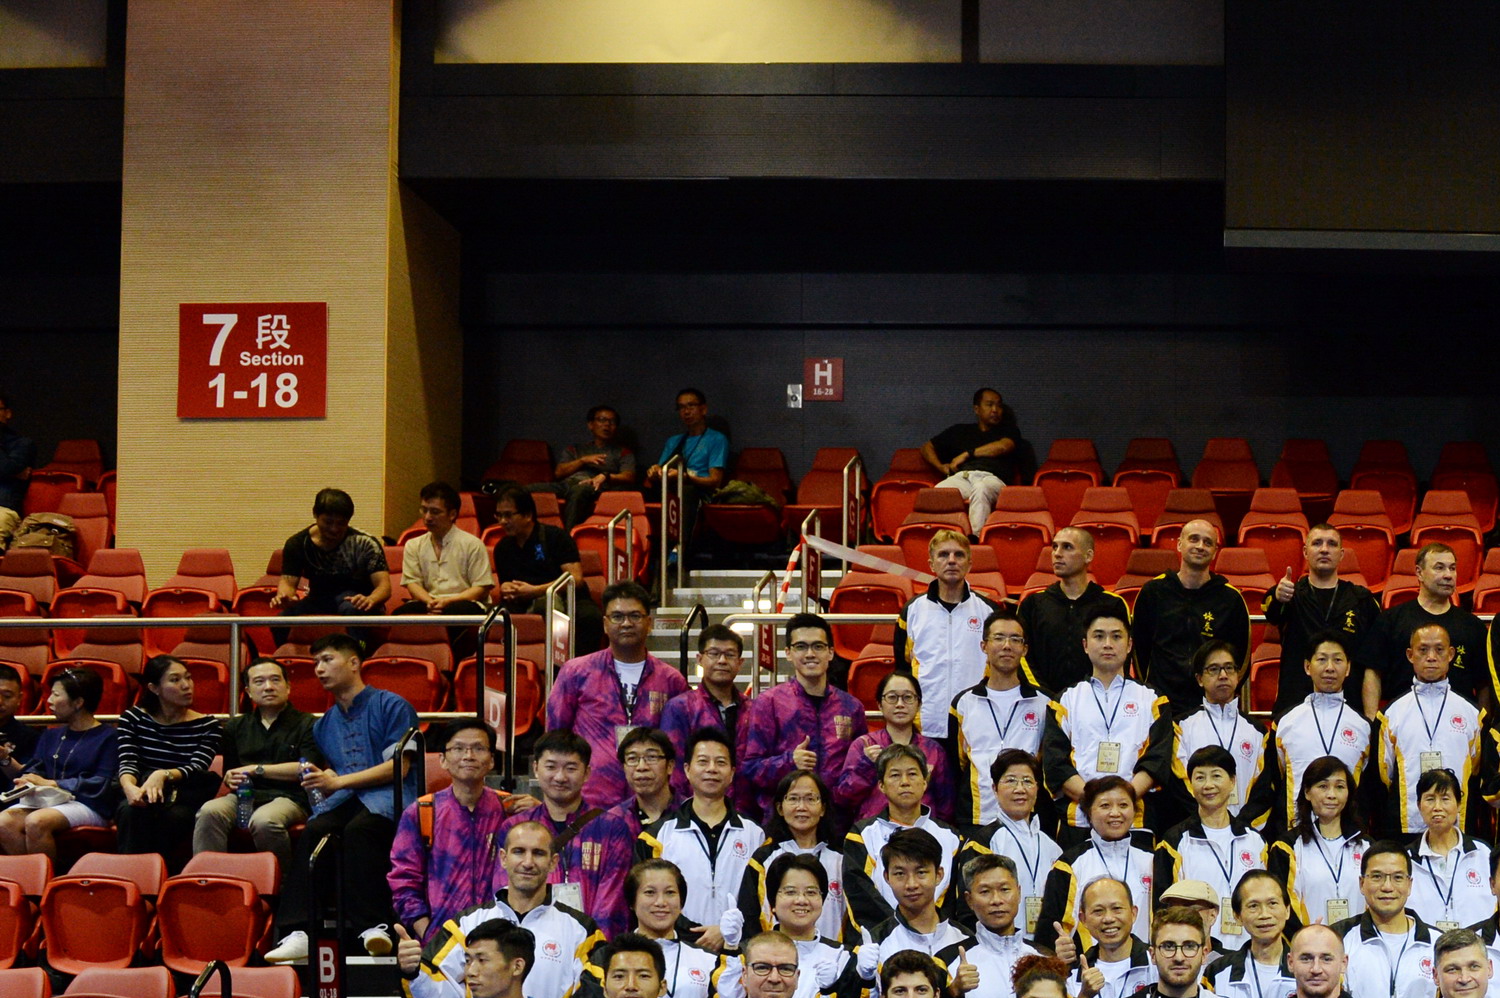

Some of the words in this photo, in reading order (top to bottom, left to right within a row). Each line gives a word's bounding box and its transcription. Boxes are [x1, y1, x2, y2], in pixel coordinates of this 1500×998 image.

[203, 314, 238, 366] 7
[256, 314, 291, 349] 段
[240, 351, 304, 366] Section
[814, 363, 832, 386] H
[208, 372, 299, 408] 1-18
[668, 499, 677, 525] G
[617, 554, 625, 580] F
[809, 554, 816, 580] F
[490, 696, 501, 728] D
[319, 946, 336, 983] B
[319, 988, 338, 998] 01-18
